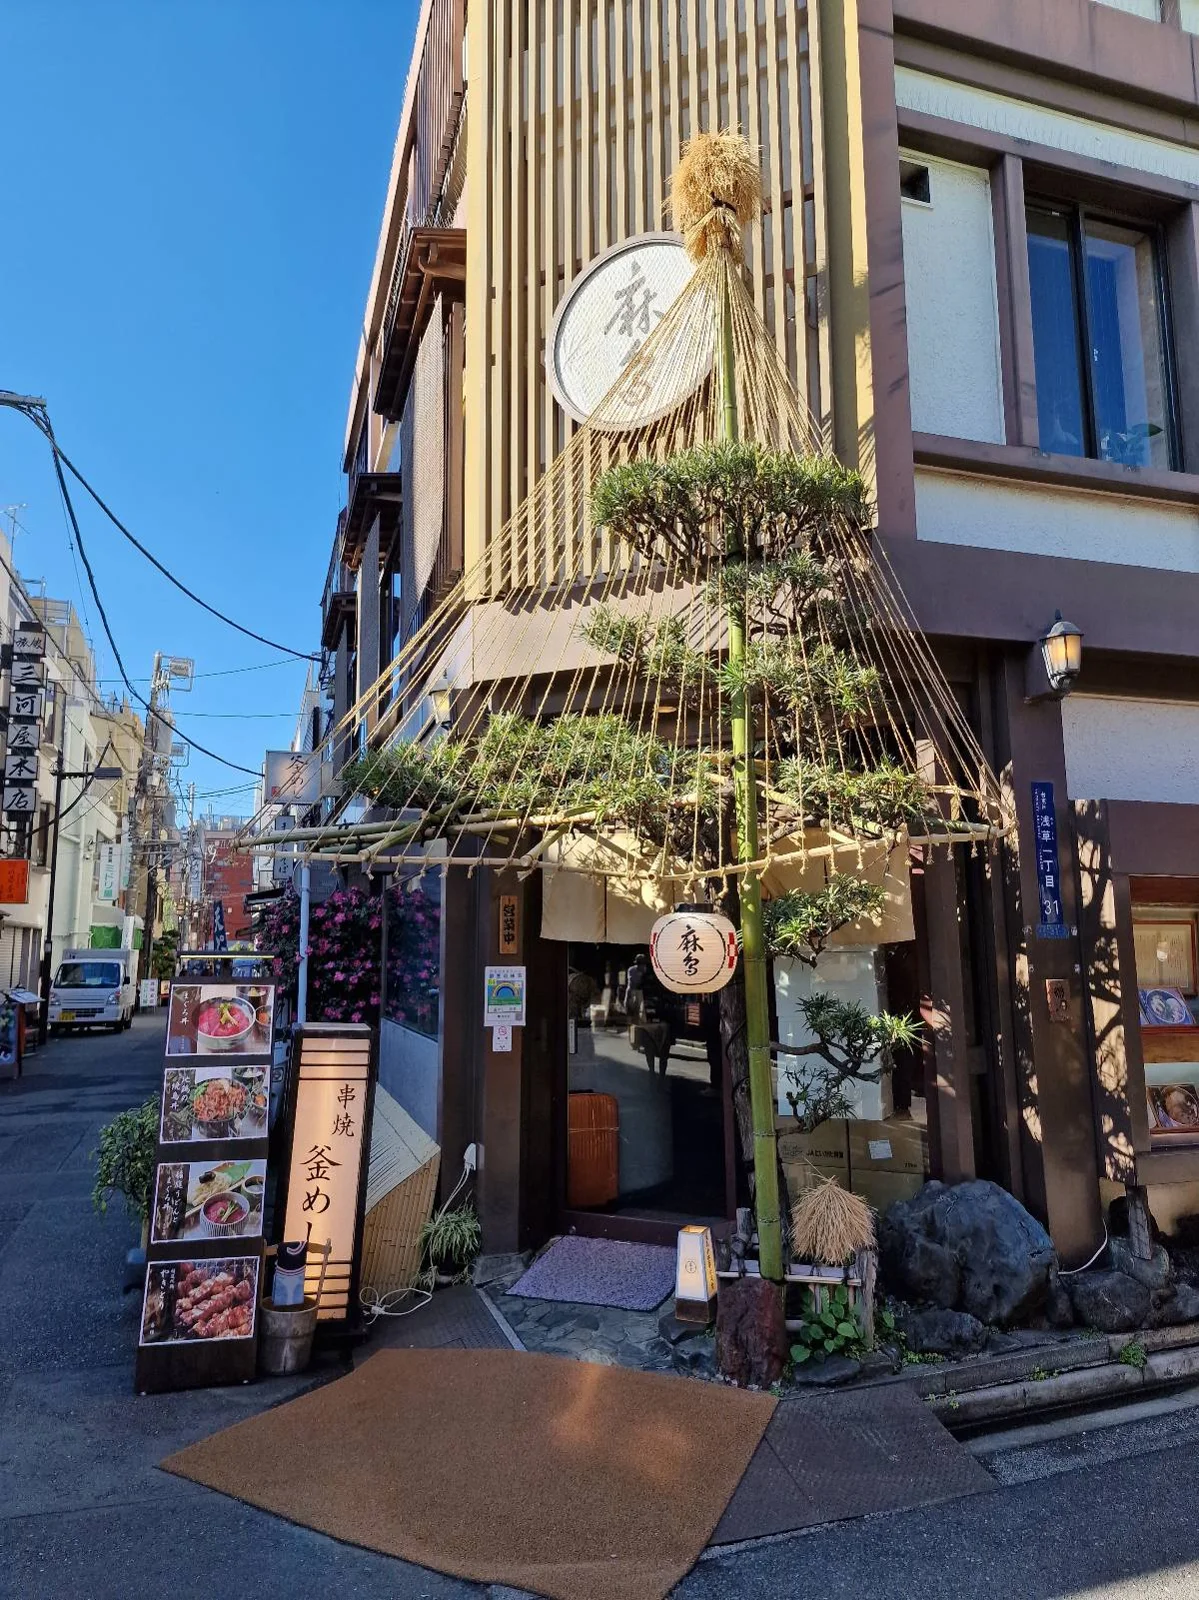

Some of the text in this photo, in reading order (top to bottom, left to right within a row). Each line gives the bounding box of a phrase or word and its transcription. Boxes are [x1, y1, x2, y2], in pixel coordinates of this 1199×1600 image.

[7, 665, 42, 810] 三河屋本店
[1041, 814, 1055, 888] 浅草一丁目
[503, 904, 515, 945] 営業中
[1043, 900, 1059, 915] 31
[677, 924, 704, 977] 麻鳥
[180, 992, 190, 1026] まぐろ丼
[331, 1083, 356, 1137] 串焼
[161, 1177, 173, 1212] まぐろ丼
